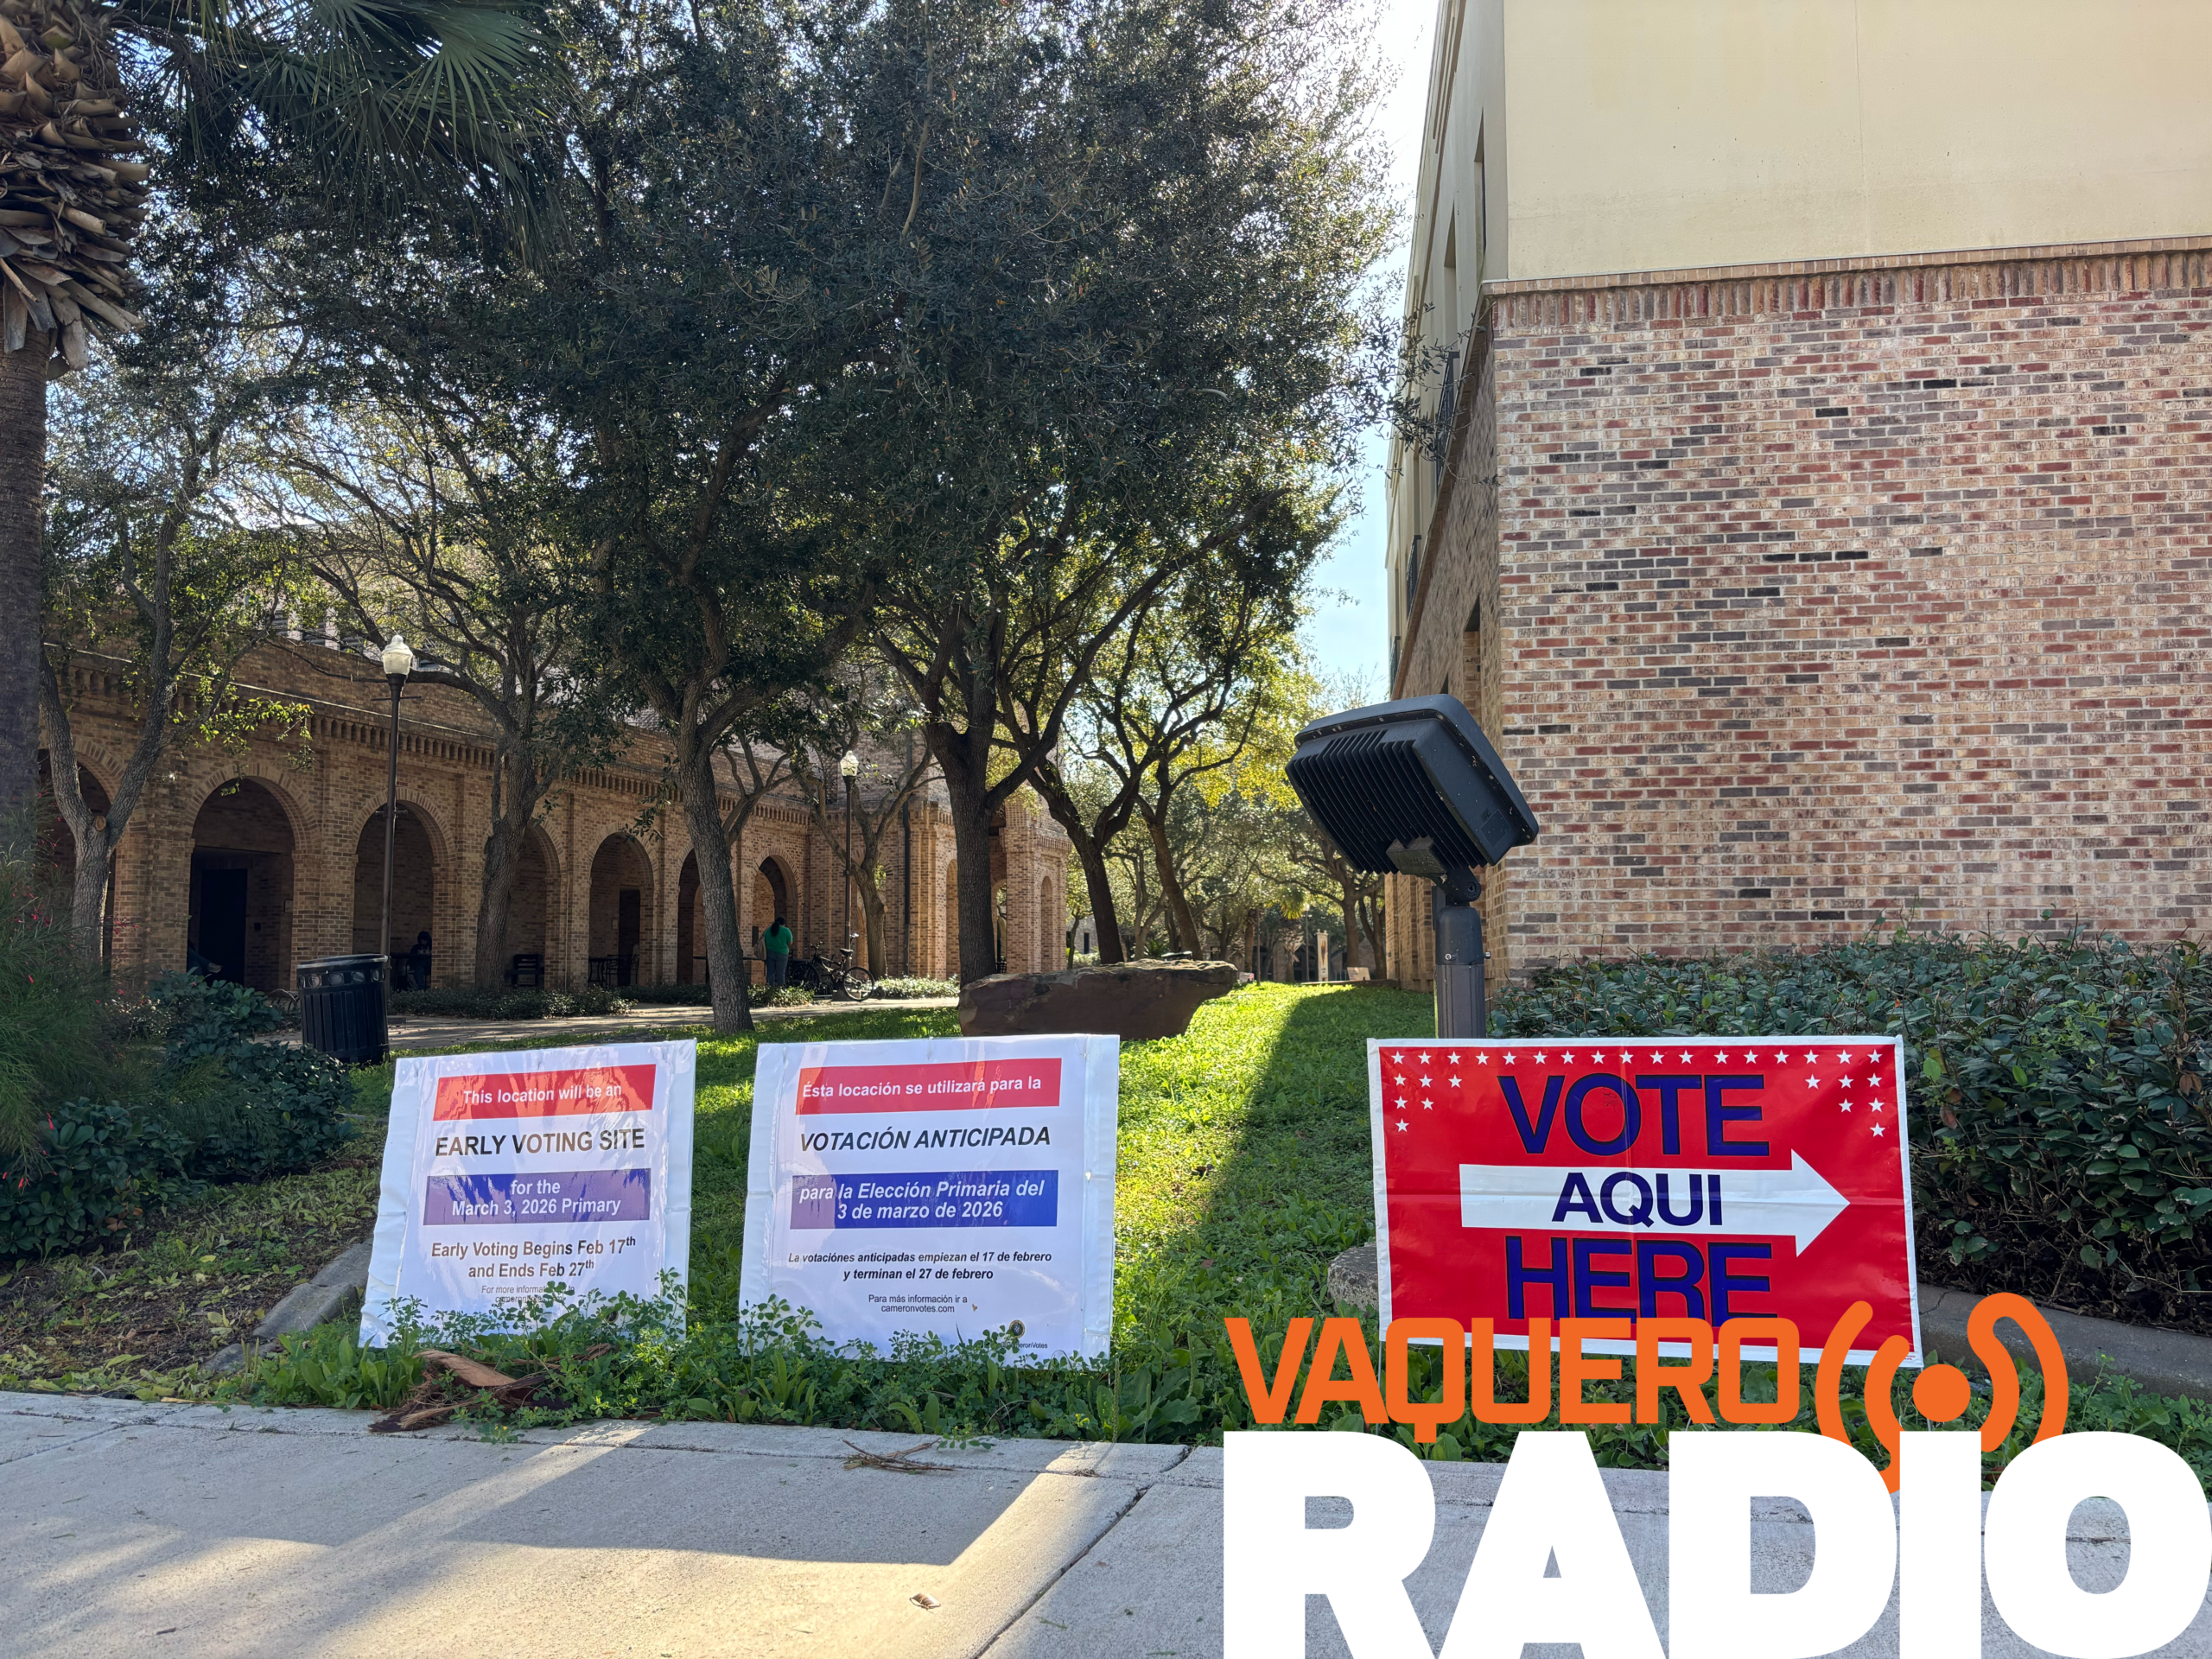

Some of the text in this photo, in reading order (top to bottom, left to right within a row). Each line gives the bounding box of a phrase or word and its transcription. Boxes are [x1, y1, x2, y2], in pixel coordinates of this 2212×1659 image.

[463, 1084, 622, 1104] This location will be an
[802, 1076, 1041, 1097] Ésta locación se utilizará para la
[1497, 1073, 1770, 1156] VOTE
[435, 1128, 645, 1156] EARLY VOTING SITE
[800, 1126, 1051, 1152] VOTACIÓN ANTICIPADA
[511, 1179, 561, 1195] for the
[799, 1179, 1045, 1204] para la Elección Primaria del
[452, 1198, 621, 1217] March 3, 2026 Primary
[1551, 1171, 1723, 1228] AQUI
[837, 1201, 1003, 1220] 3 de marzo de 2026
[431, 1243, 468, 1260] Early
[473, 1242, 518, 1259] Voting
[523, 1241, 573, 1259] Begins
[577, 1239, 604, 1255] Feb
[788, 1252, 1052, 1264] La votaciónes anticipadas empiezan el 17 de febrero
[468, 1263, 494, 1278] and
[499, 1262, 535, 1278] Ends
[539, 1262, 565, 1277] Feb
[843, 1268, 994, 1281] y terminan el 27 de febrero
[481, 1285, 494, 1294] For
[516, 1285, 553, 1294] informat
[1505, 1236, 1777, 1327] HERE
[868, 1294, 887, 1303] Para
[889, 1294, 906, 1303] más
[908, 1294, 953, 1303] información
[880, 1305, 955, 1313] cameronvotes.com
